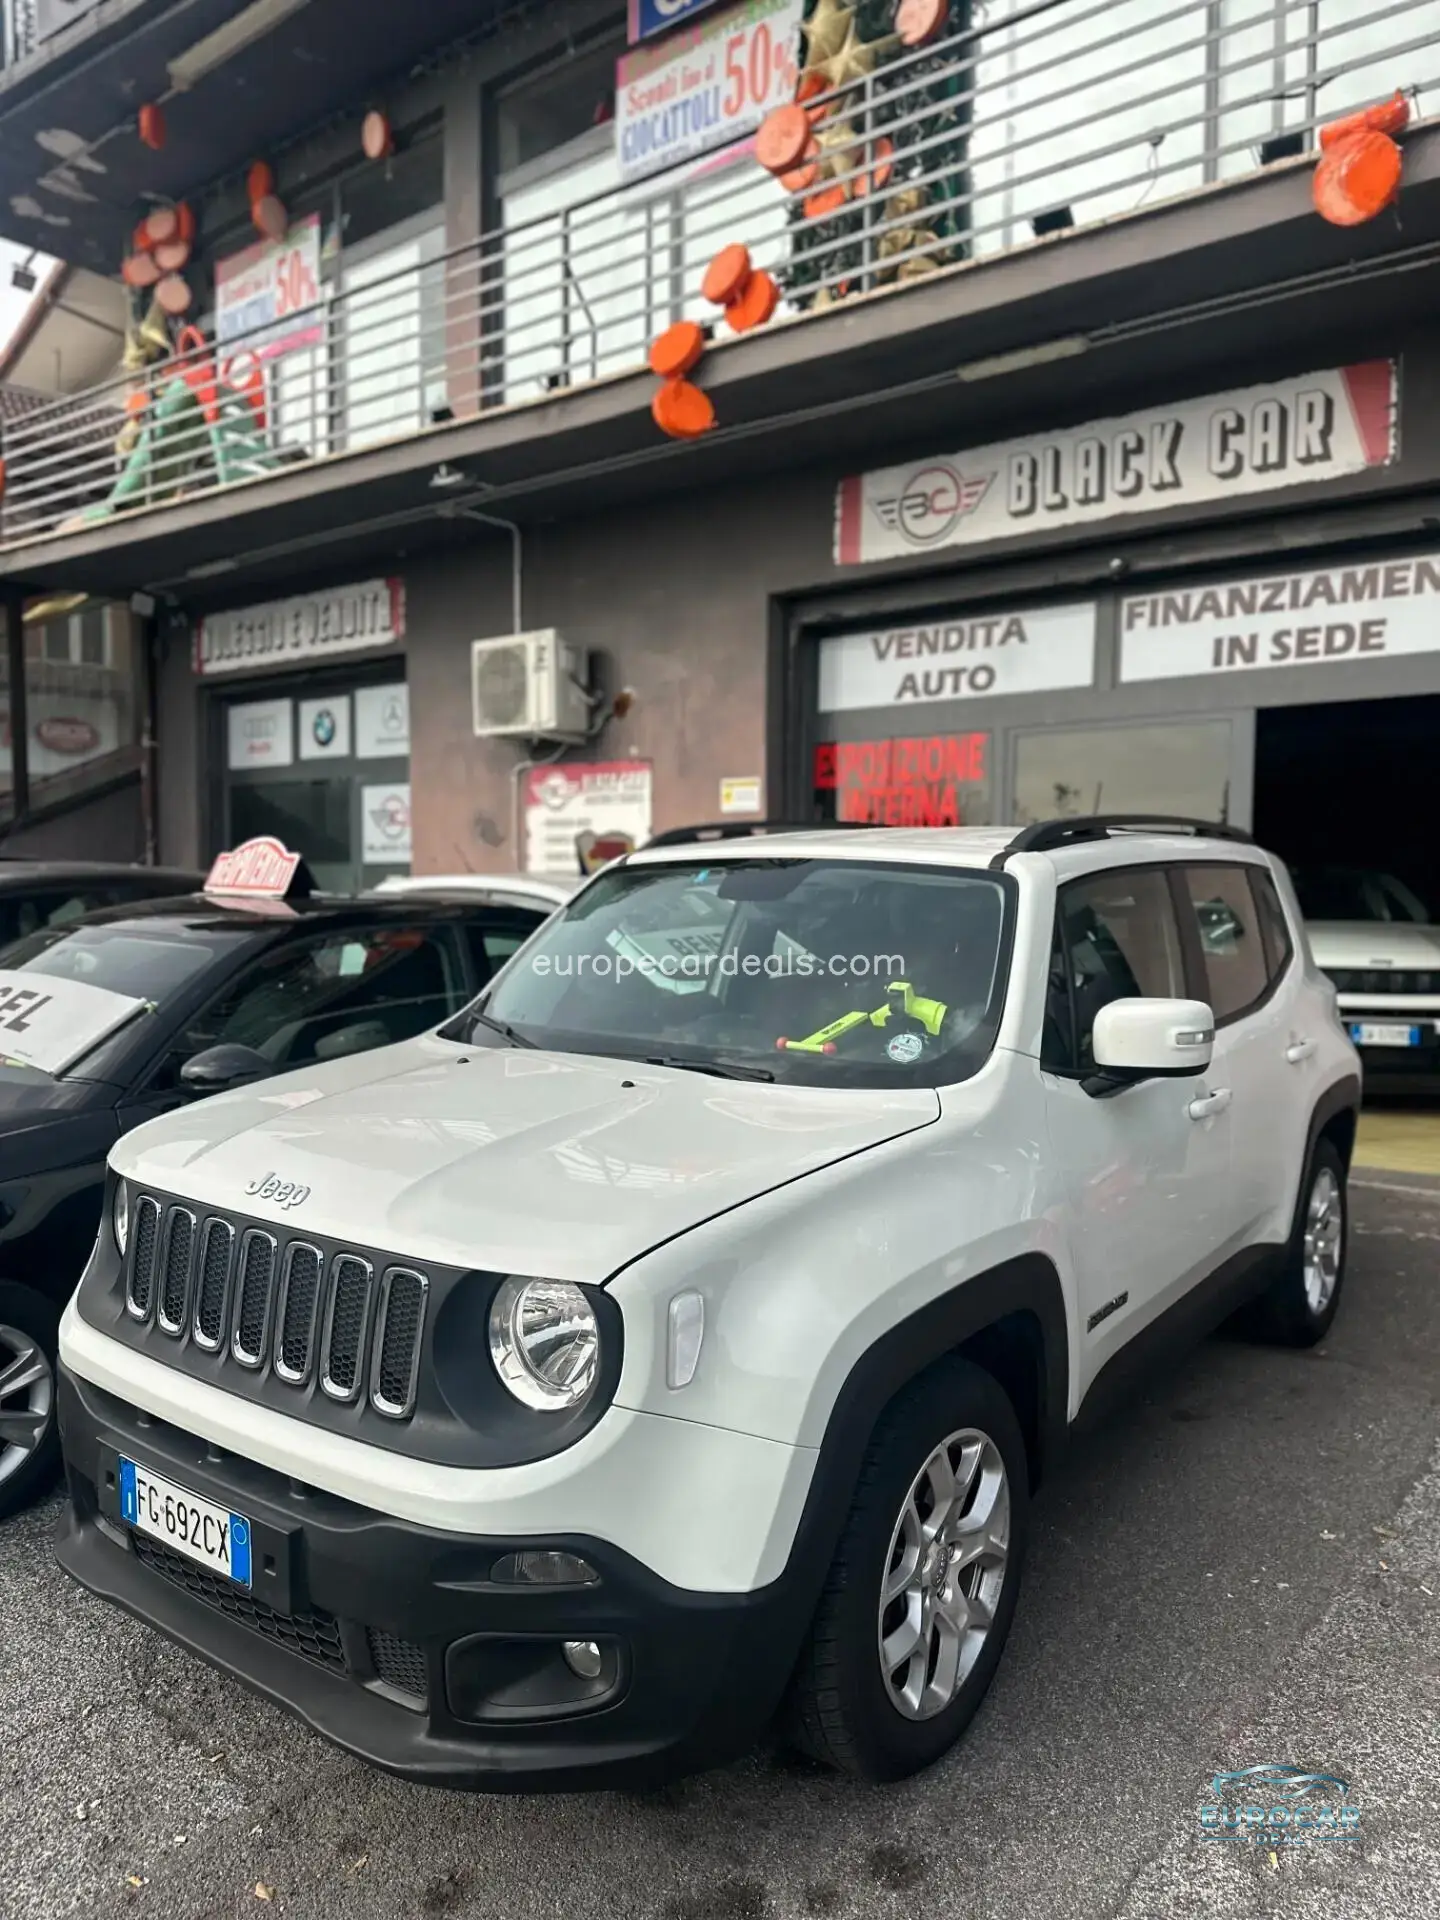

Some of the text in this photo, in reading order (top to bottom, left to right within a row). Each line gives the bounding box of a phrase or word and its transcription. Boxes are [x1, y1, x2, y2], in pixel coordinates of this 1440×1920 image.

[1007, 389, 1335, 517] BLACK CAR
[872, 617, 1028, 662] VENDITA
[1211, 618, 1388, 668] IN SEDE
[895, 664, 996, 701] AUTO
[245, 1171, 311, 1210] Jeep
